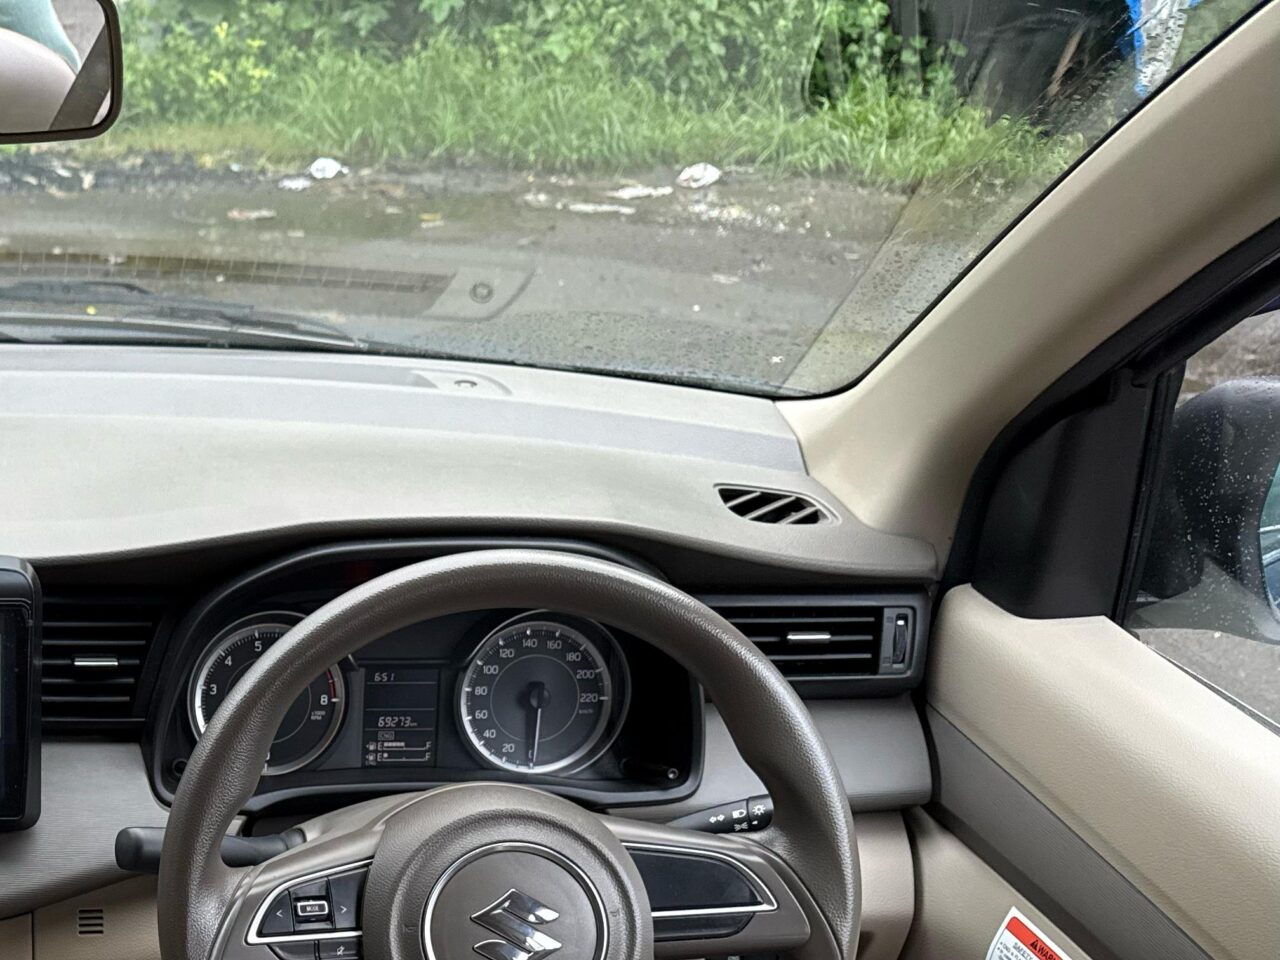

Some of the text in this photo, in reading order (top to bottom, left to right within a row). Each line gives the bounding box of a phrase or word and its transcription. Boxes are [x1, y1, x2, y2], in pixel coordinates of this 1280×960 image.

[254, 641, 262, 652] 5
[522, 639, 538, 648] 140
[547, 640, 562, 649] 160
[499, 649, 515, 658] 120
[566, 652, 582, 662] 180
[224, 656, 232, 667] 4
[483, 665, 499, 675] 100
[576, 670, 595, 679] 200
[209, 684, 217, 695] 3
[474, 686, 488, 696] 80
[320, 694, 329, 706] 8
[580, 693, 599, 703] 220
[475, 710, 488, 719] 60
[378, 716, 411, 728] 69273
[483, 729, 496, 739] 40
[377, 741, 383, 751] E
[502, 743, 515, 753] 20
[377, 752, 382, 762] E
